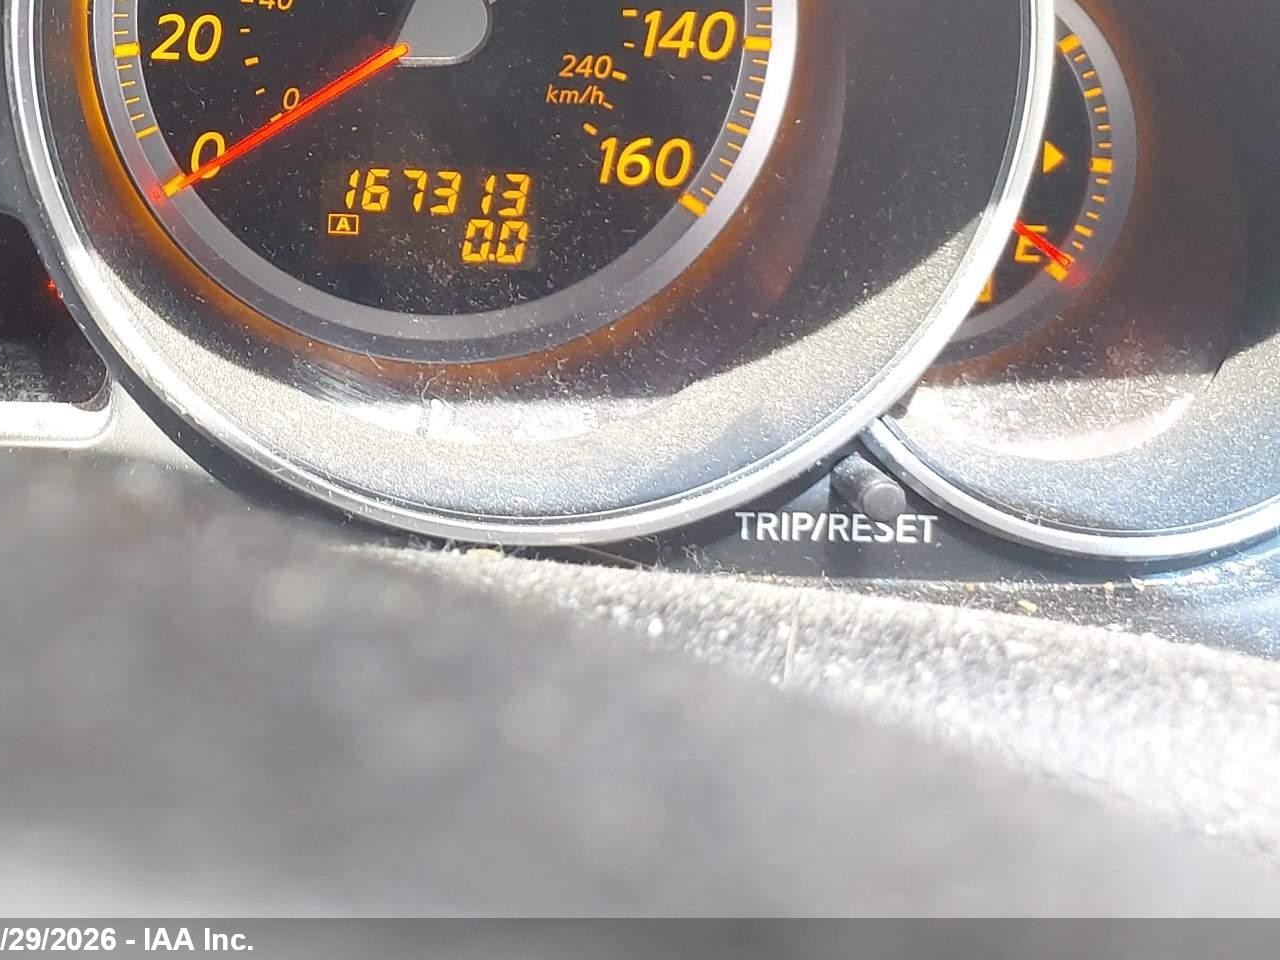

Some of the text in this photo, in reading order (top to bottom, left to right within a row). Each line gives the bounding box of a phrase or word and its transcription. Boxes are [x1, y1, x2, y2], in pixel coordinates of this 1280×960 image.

[150, 13, 222, 62] 20
[643, 10, 736, 60] 140
[558, 54, 613, 79] 240
[282, 87, 300, 110] 0
[545, 84, 605, 105] km/h
[190, 131, 225, 179] 0
[599, 136, 693, 187] 160
[345, 168, 530, 217] 167313
[336, 217, 351, 231] A
[461, 218, 528, 264] 0.0
[735, 511, 938, 543] TRIP/RESET
